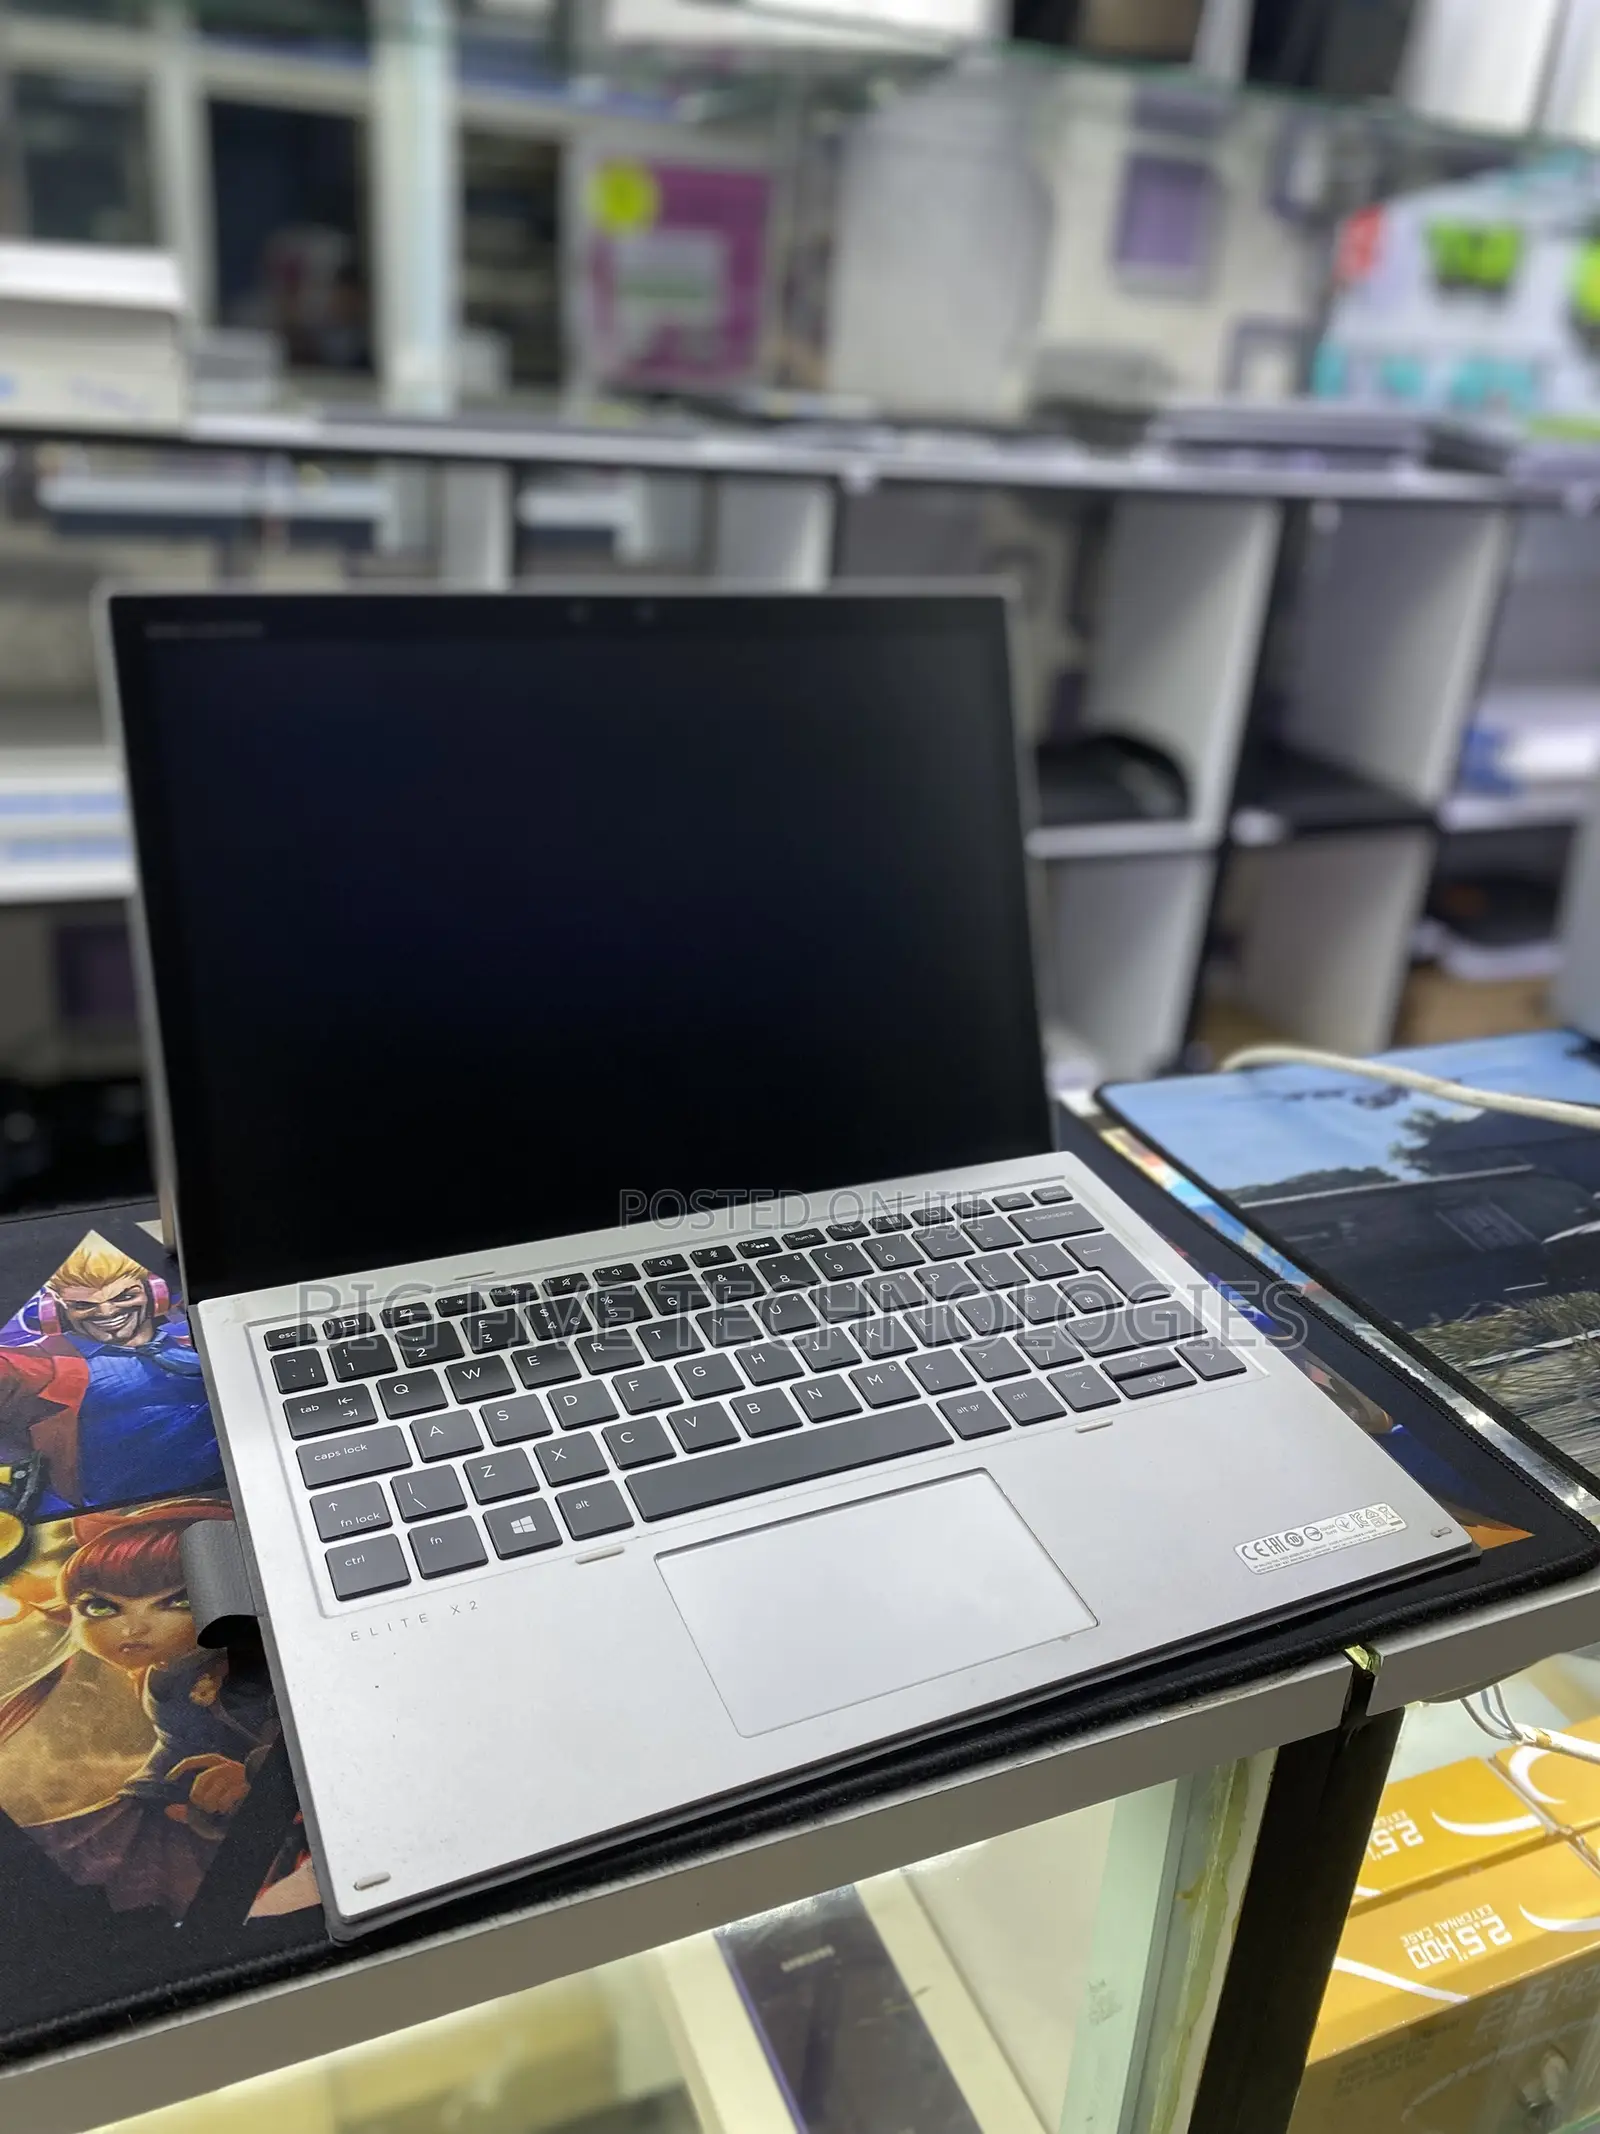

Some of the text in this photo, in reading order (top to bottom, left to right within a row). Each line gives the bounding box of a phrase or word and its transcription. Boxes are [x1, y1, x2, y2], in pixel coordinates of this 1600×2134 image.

[833, 1263, 844, 1272] 9
[716, 1273, 728, 1282] &
[779, 1274, 792, 1284] 8
[929, 1272, 940, 1282] P
[724, 1285, 732, 1295] 7
[880, 1283, 892, 1292] O
[600, 1296, 614, 1305] %
[666, 1296, 678, 1306] 6
[1084, 1296, 1093, 1304] #
[540, 1308, 550, 1318] $
[607, 1308, 618, 1318] 5
[768, 1304, 782, 1316] U
[547, 1321, 558, 1330] 4
[712, 1316, 724, 1327] Y
[919, 1318, 932, 1327] L
[278, 1330, 297, 1340] esc
[482, 1333, 493, 1344] 3
[650, 1330, 662, 1340] T
[865, 1328, 880, 1339] K
[590, 1342, 605, 1353] R
[812, 1340, 820, 1351] J
[416, 1347, 428, 1358] 2
[526, 1355, 541, 1367] E
[750, 1352, 766, 1365] H
[348, 1362, 355, 1372] 1
[692, 1366, 707, 1378] G
[462, 1367, 482, 1380] W
[866, 1374, 884, 1386] M
[393, 1383, 410, 1395] Q
[628, 1380, 641, 1392] F
[806, 1388, 824, 1400] N
[1012, 1391, 1028, 1402] ctrl
[564, 1395, 578, 1406] D
[300, 1404, 320, 1414] tab
[746, 1402, 762, 1414] B
[956, 1402, 980, 1414] alt gr
[496, 1410, 510, 1422] S
[684, 1416, 698, 1428] V
[430, 1425, 444, 1438] A
[620, 1432, 635, 1444] C
[314, 1444, 368, 1462] caps lock
[551, 1448, 567, 1462] X
[480, 1464, 496, 1478] Z
[574, 1500, 591, 1510] alt
[340, 1512, 381, 1528] fn lock
[430, 1536, 443, 1546] fn
[344, 1554, 366, 1567] ctrl
[350, 1600, 479, 1642] ELITE X2
[1399, 1903, 1495, 1947] EXTERNAL CASE
